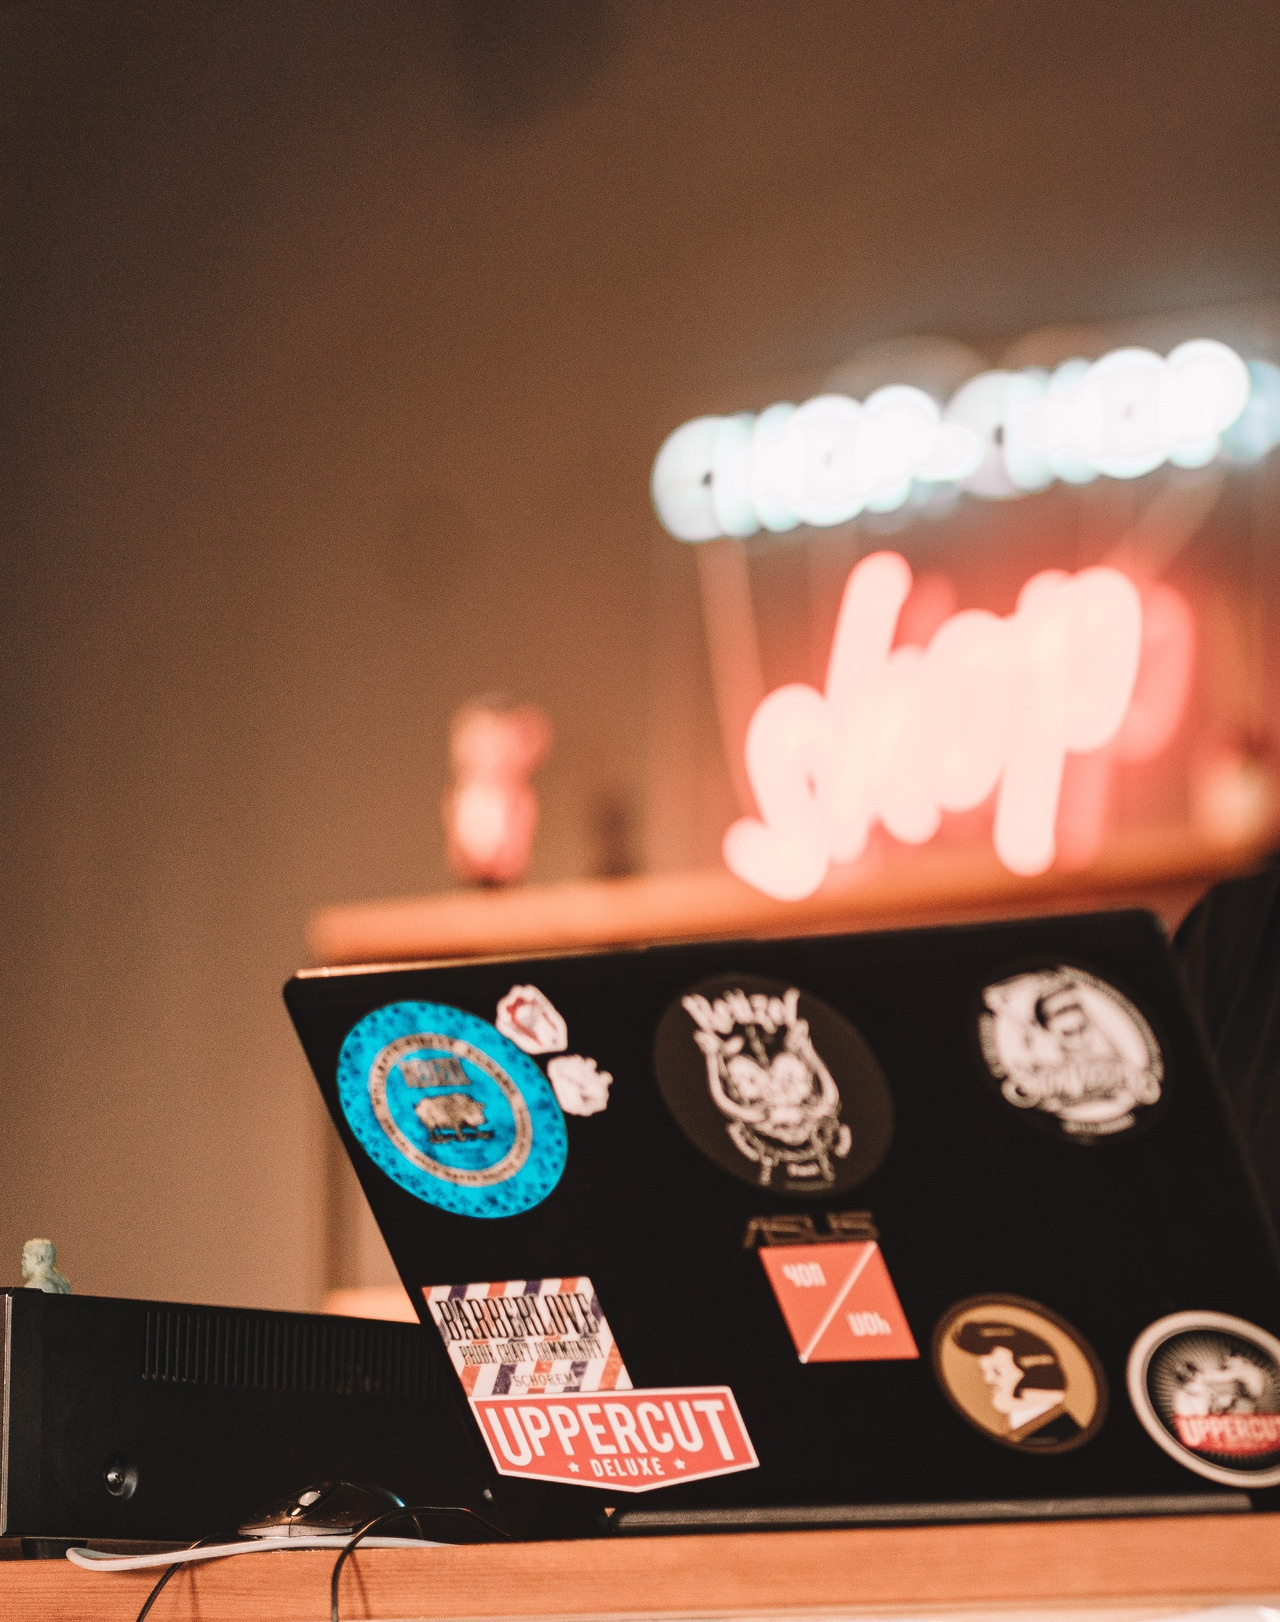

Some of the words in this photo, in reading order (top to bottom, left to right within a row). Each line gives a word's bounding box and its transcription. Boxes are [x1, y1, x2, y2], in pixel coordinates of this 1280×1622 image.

[723, 550, 1141, 900] shop
[743, 1210, 880, 1249] ASUS
[435, 1293, 600, 1341] BARBERLOVE
[534, 1337, 606, 1362] COMMUNITY
[512, 1372, 577, 1388] SCHOREM
[485, 1400, 735, 1467] UPPERCUT
[589, 1456, 666, 1477] DELUXE
